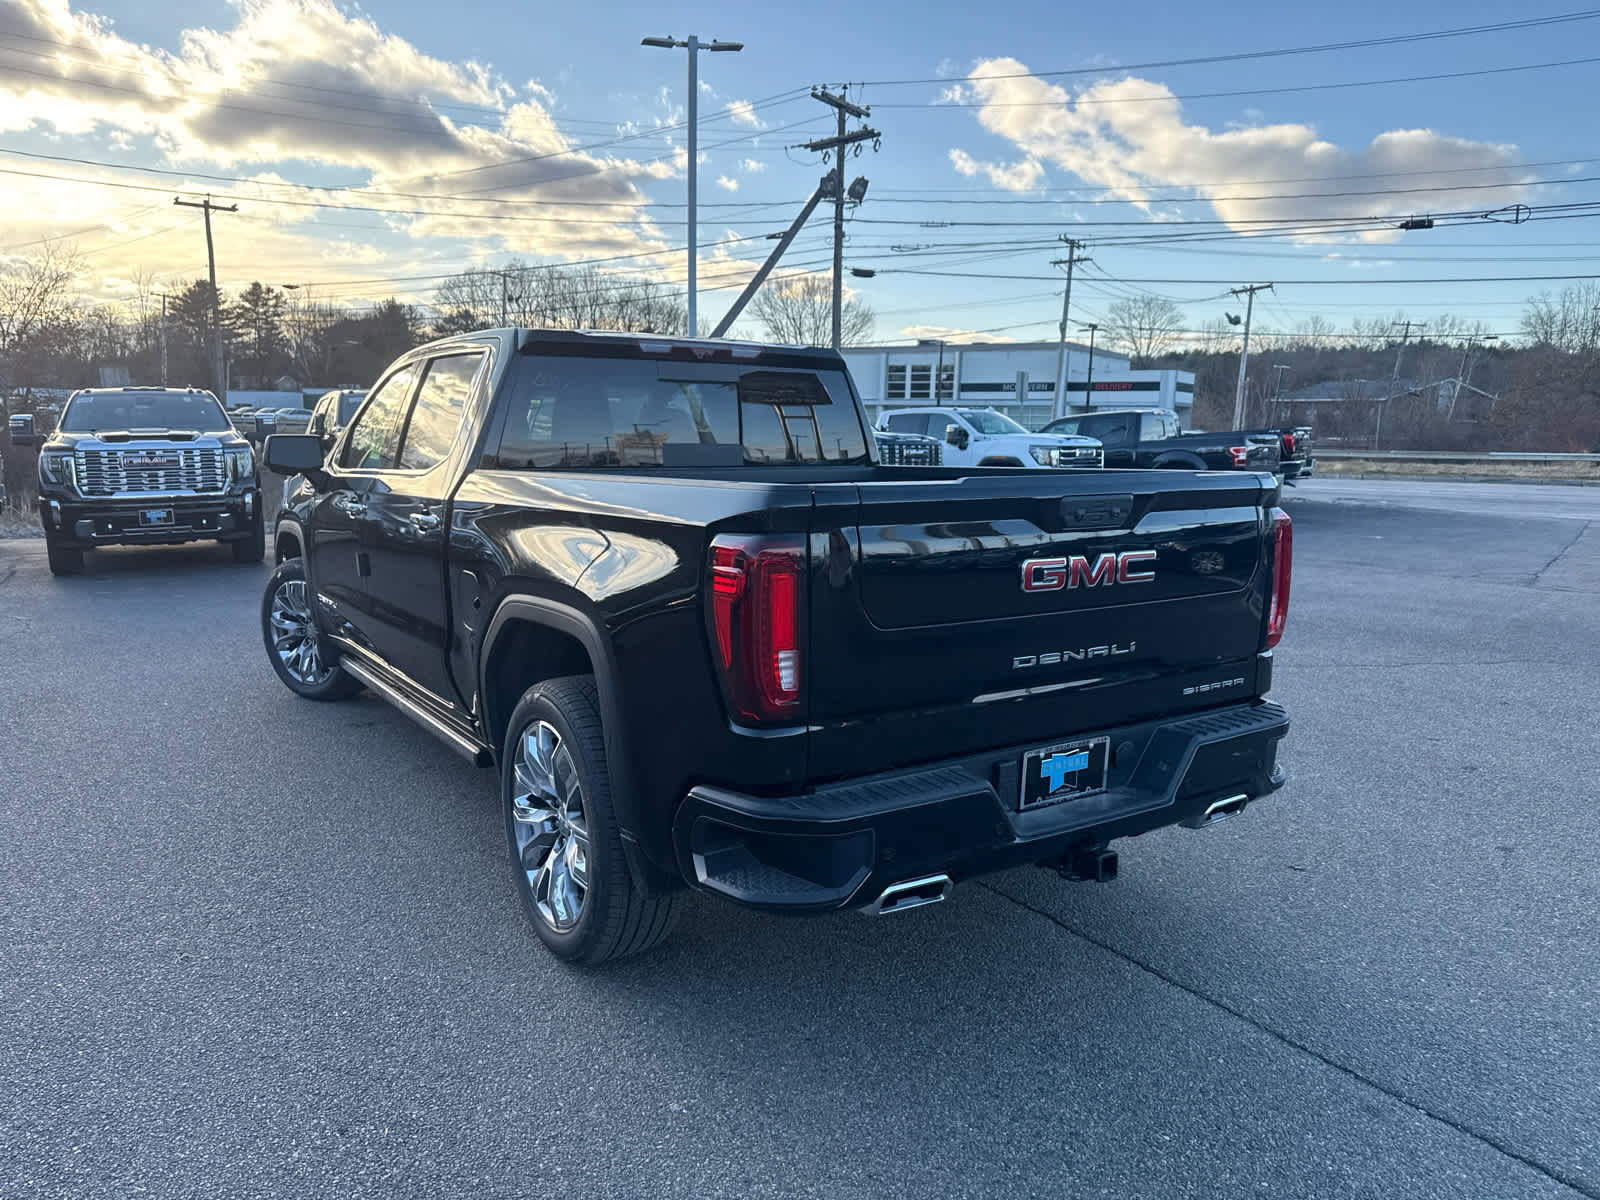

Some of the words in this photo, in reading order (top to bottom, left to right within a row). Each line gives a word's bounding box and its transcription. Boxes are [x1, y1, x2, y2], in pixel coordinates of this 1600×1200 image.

[1002, 383, 1048, 391] MCERN
[1095, 383, 1132, 391] DELIVERY
[1022, 549, 1157, 592] GMC
[1012, 641, 1136, 669] DENALI
[1182, 677, 1245, 696] SIERRA
